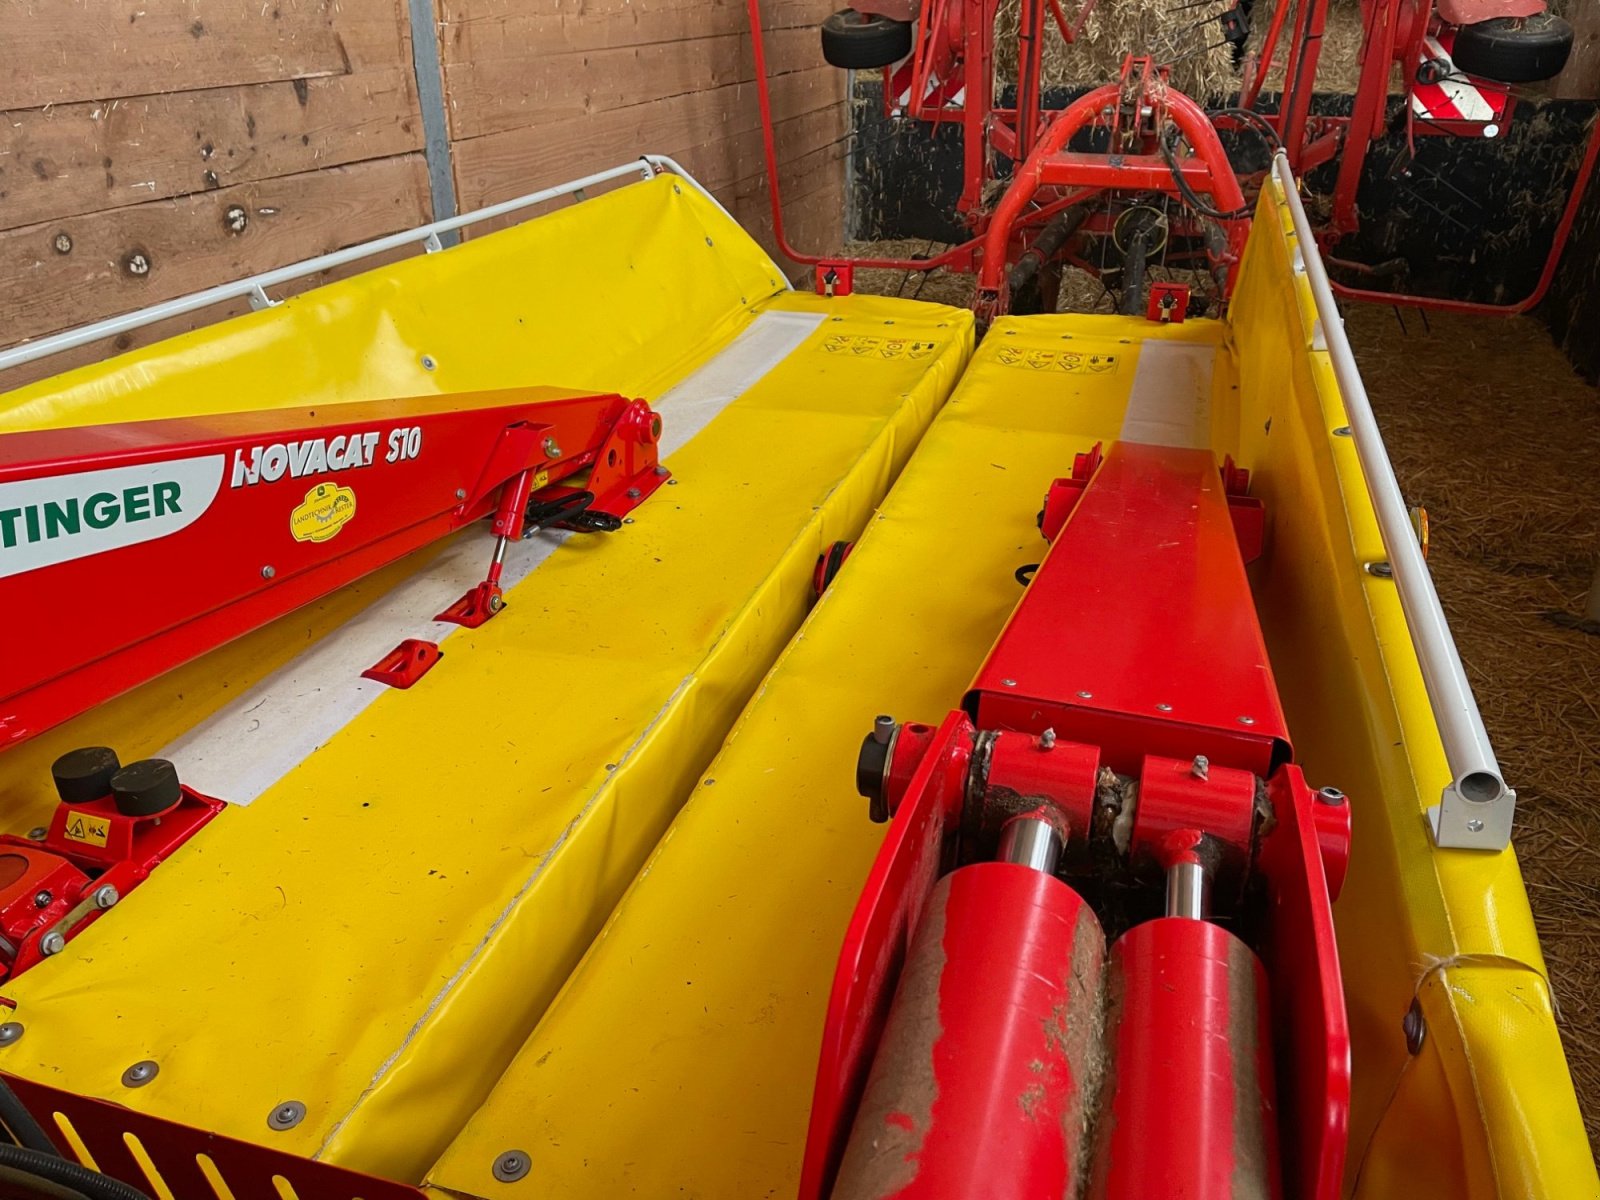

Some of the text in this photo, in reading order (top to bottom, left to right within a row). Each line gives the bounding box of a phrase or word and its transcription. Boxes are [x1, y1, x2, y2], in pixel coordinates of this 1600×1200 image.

[231, 426, 422, 488] NOVACAT S10
[293, 505, 332, 526] LANDTECHNIK
